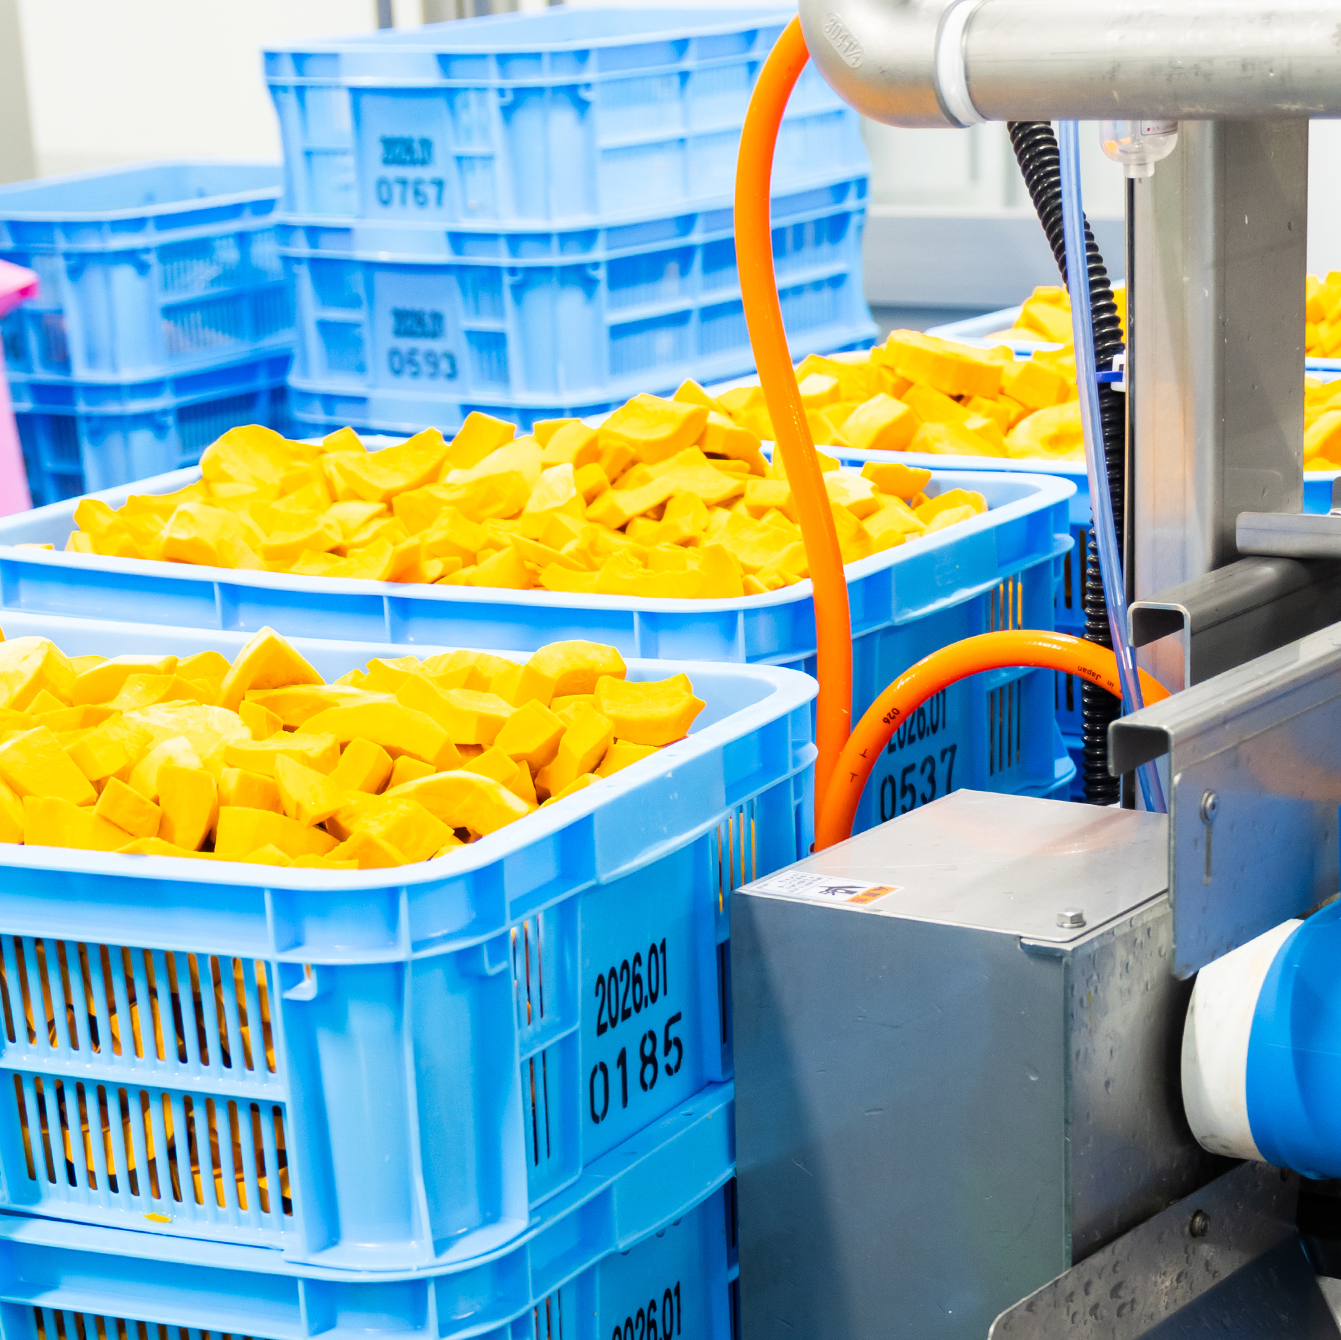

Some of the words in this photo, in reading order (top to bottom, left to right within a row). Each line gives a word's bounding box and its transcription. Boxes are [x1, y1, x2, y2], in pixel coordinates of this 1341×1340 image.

[376, 176, 444, 207] 0767
[1077, 665, 1102, 680] Japan
[880, 743, 957, 822] 0537
[595, 937, 667, 1037] 2026.01
[589, 1011, 683, 1124] 0185
